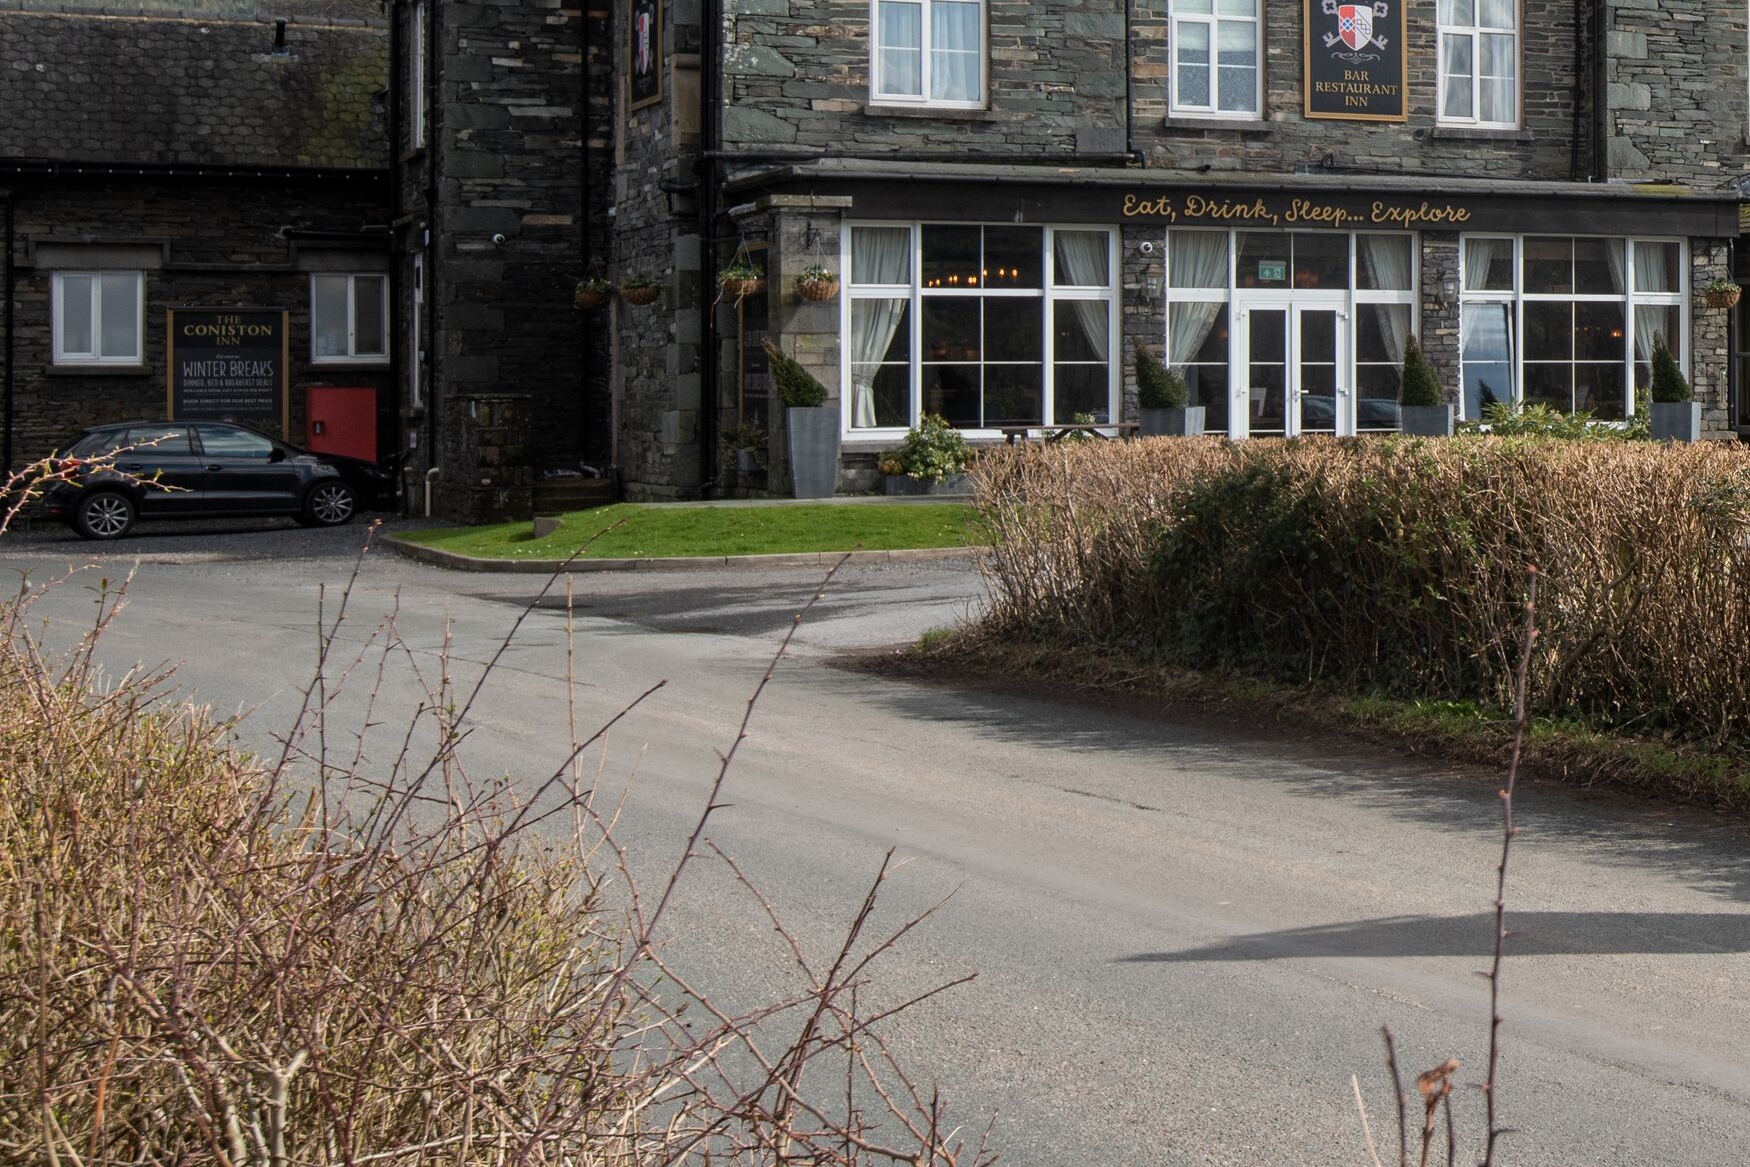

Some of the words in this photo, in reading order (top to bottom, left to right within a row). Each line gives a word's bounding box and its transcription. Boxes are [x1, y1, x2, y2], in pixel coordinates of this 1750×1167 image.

[1344, 69, 1369, 81] BAR
[1315, 82, 1398, 96] RESTAURANT
[1344, 96, 1368, 107] INN
[1122, 194, 1176, 222] Eat,
[1184, 195, 1278, 226] Drink,
[1285, 199, 1364, 227] Sleep...
[1371, 201, 1471, 228] Explore
[216, 315, 241, 324] THE
[184, 324, 272, 336] CONISTON
[216, 336, 241, 346] INN
[183, 360, 226, 377] WINTER
[230, 360, 274, 377] BREAKS
[207, 378, 218, 387] BED
[219, 378, 224, 387] &
[225, 378, 254, 387] BREAKFAST
[256, 378, 273, 387] DEALS
